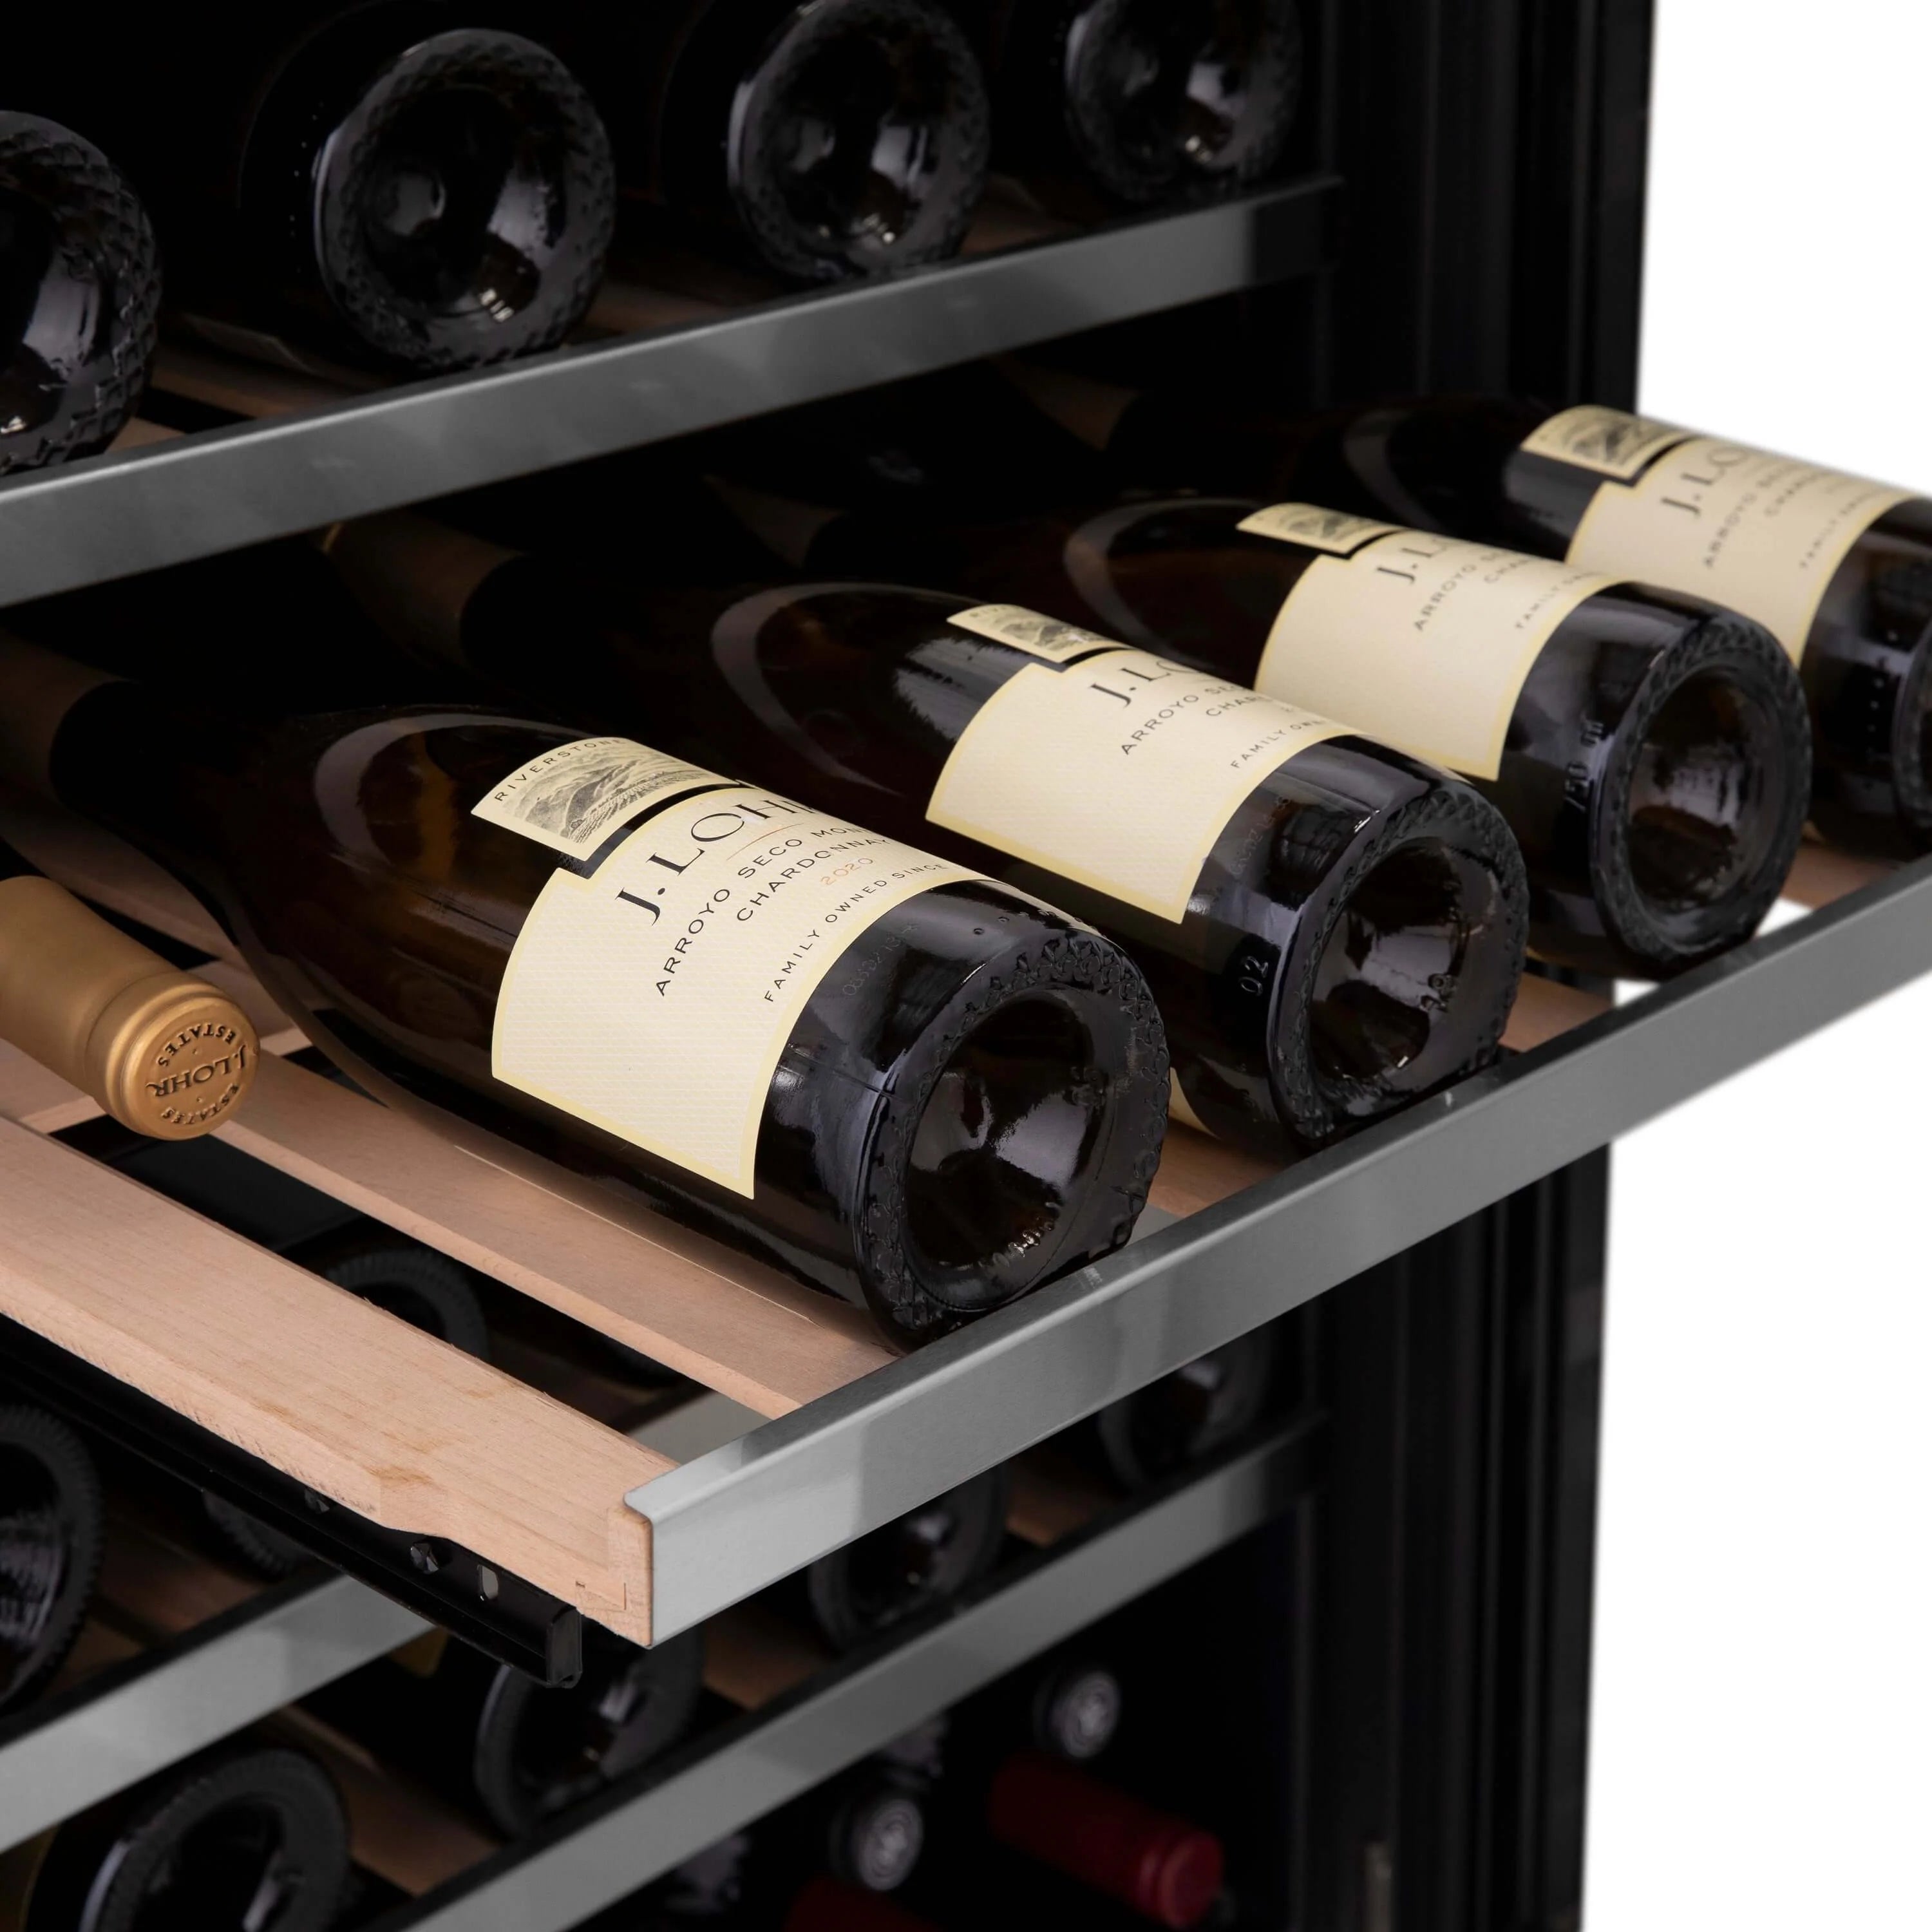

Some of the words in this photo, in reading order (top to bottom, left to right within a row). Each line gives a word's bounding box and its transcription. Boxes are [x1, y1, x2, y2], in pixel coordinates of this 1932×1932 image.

[1121, 694, 1199, 755] ARROYO
[1230, 729, 1287, 769] FAMILY
[494, 739, 627, 802] RIVERSTONE
[737, 839, 891, 921] CHARDONNAY
[820, 857, 874, 886] 2020
[656, 889, 730, 997] ARROYO
[737, 838, 802, 878] SECO
[764, 929, 820, 1002] FAMILY
[825, 880, 887, 923] OWNED
[892, 864, 948, 878] SINCE
[157, 1021, 236, 1067] ESTATES
[160, 1083, 240, 1124] ESTATES
